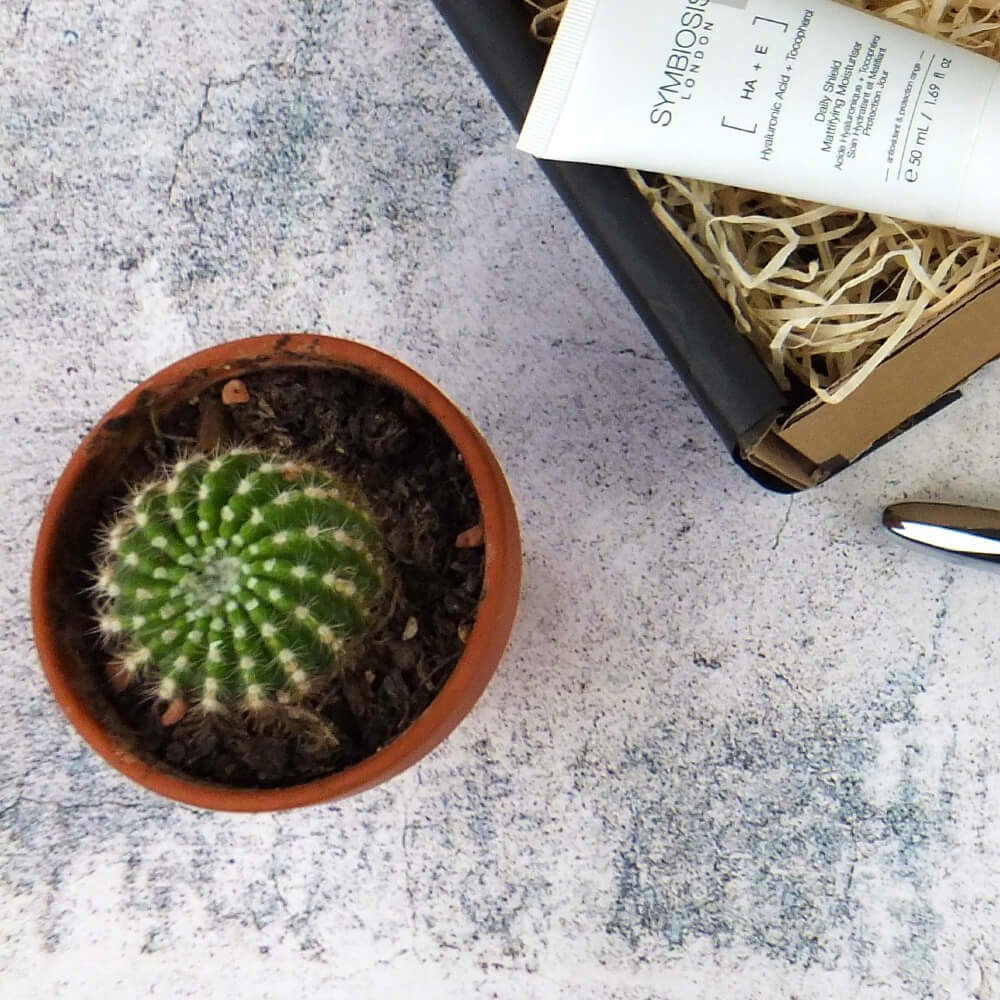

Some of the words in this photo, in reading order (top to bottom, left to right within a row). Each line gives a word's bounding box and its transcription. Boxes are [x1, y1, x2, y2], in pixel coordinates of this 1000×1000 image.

[681, 21, 714, 101] LONDON
[740, 79, 758, 100] HA
[754, 44, 769, 55] E
[823, 60, 843, 93] Shield
[940, 57, 953, 70] oz
[814, 95, 833, 123] Daily
[821, 98, 846, 153] Mattifying
[835, 41, 863, 97] Moisturiser
[862, 90, 882, 137] Protection
[877, 70, 889, 90] Jour
[923, 83, 941, 105] 1.69
[760, 101, 783, 161] Hyaluronic
[774, 74, 791, 100] Acid
[915, 125, 930, 146] mL
[908, 150, 923, 167] 50
